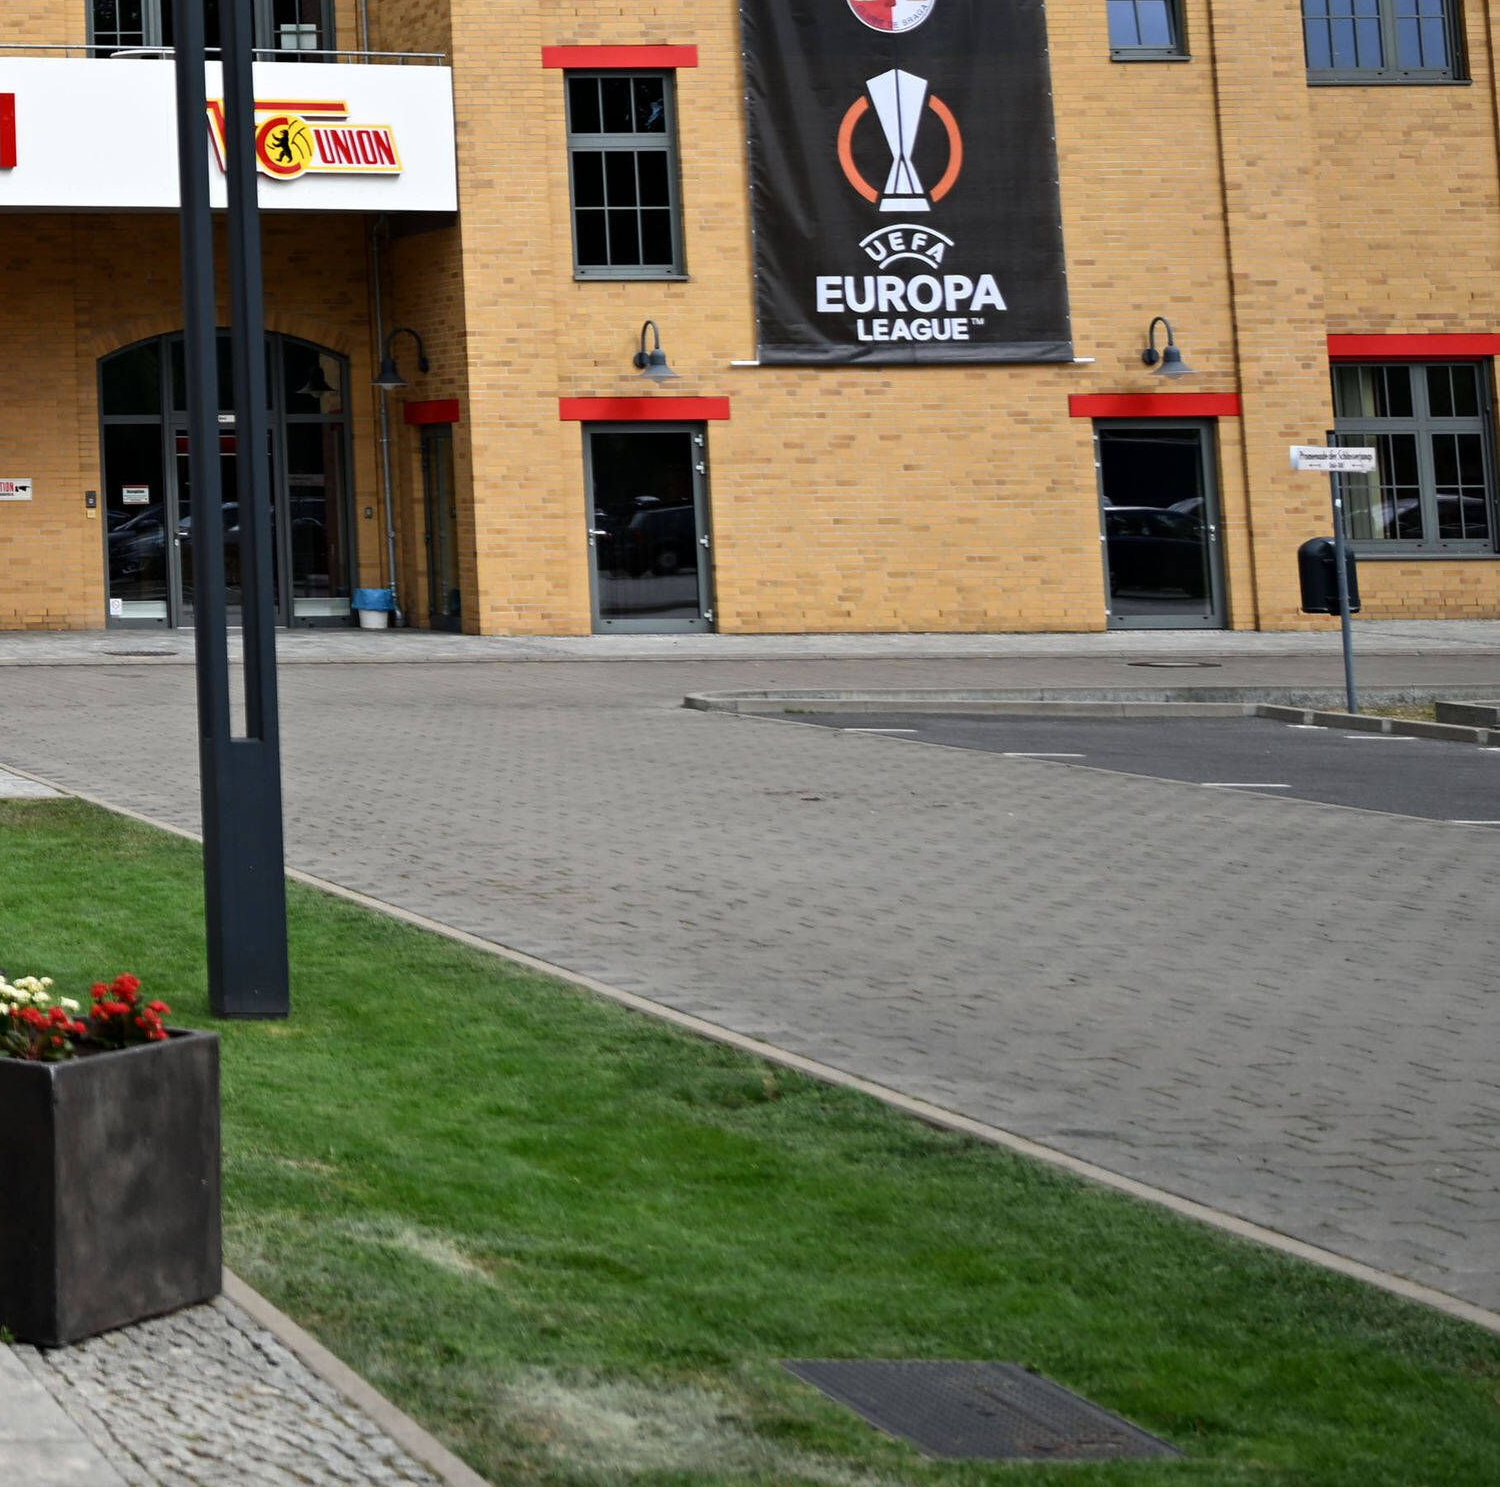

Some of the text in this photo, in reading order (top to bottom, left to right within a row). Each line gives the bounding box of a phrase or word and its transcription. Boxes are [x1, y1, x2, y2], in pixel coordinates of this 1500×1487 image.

[314, 128, 396, 165] UNION
[864, 231, 947, 264] UEFA
[815, 273, 1007, 314] EUROPA
